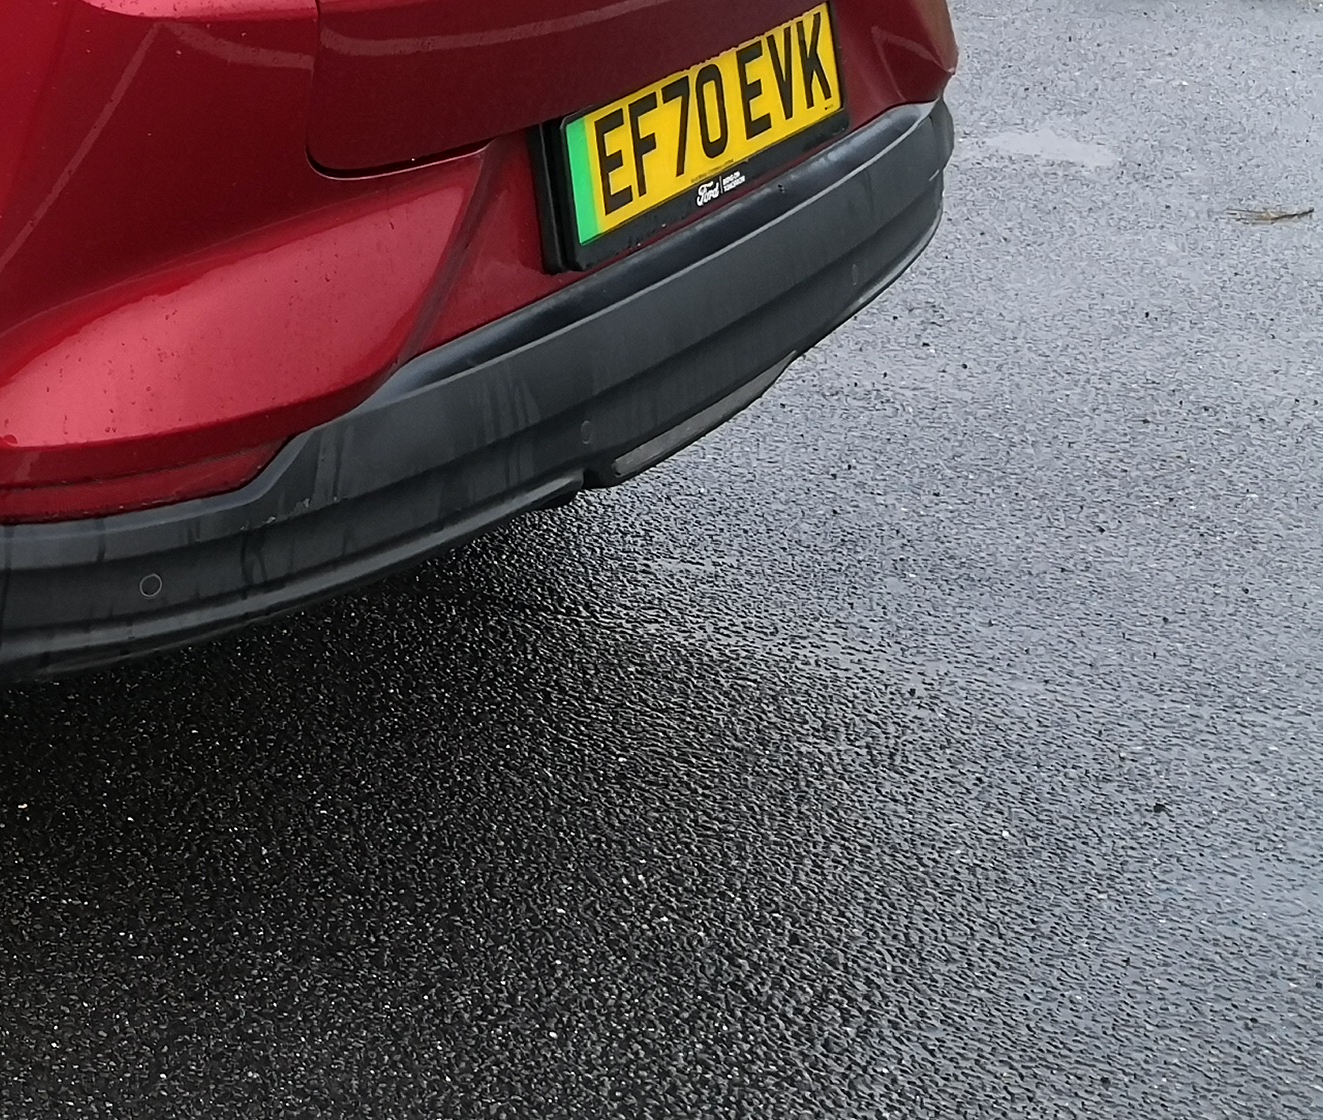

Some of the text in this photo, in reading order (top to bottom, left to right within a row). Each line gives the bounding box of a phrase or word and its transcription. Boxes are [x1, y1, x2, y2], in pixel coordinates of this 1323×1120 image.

[594, 12, 832, 216] EF70 EVK
[697, 181, 720, 207] Ford
